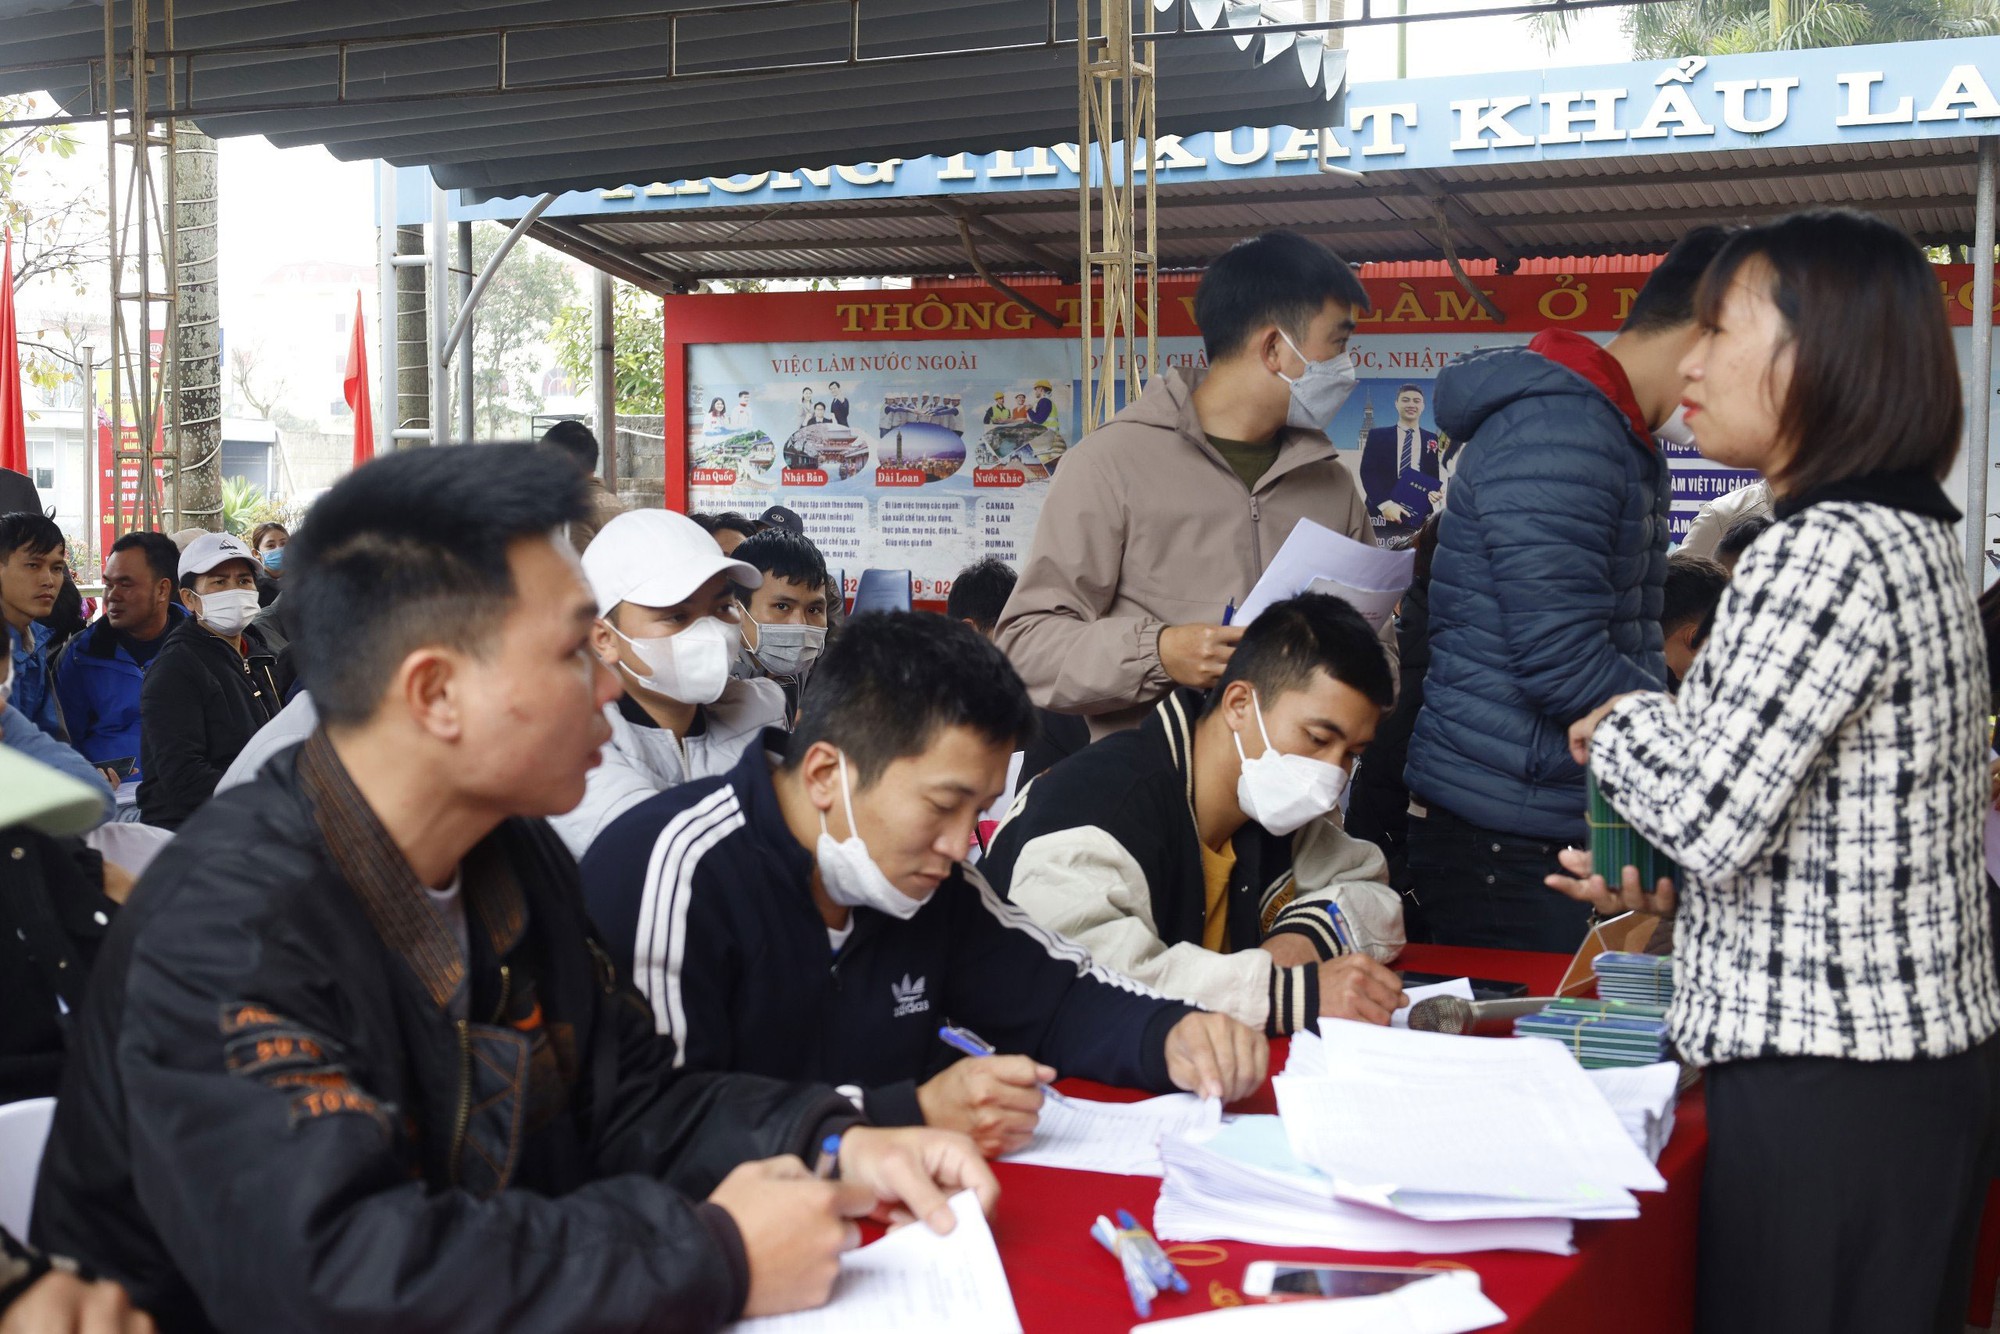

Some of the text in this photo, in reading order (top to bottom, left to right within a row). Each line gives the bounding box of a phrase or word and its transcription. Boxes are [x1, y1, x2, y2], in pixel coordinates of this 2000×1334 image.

[1449, 55, 1800, 151] KHẨU
[836, 293, 1036, 332] THÔNG
[1538, 274, 1588, 321] Ở
[771, 350, 978, 377] VIỆC LÀM NƯỚC NGOÀI
[1166, 349, 1209, 369] CHÂ
[1388, 347, 1449, 372] NHẬT
[693, 469, 734, 482] Hàn Quốc
[783, 471, 824, 484] Nhật Bản
[878, 472, 919, 483] Đài Loan
[975, 471, 1022, 483] Nước Khác
[1670, 475, 1686, 492] ÀM
[1711, 478, 1726, 495] TẠI
[985, 502, 1014, 510] CANADA
[985, 515, 1010, 523] BA LAN
